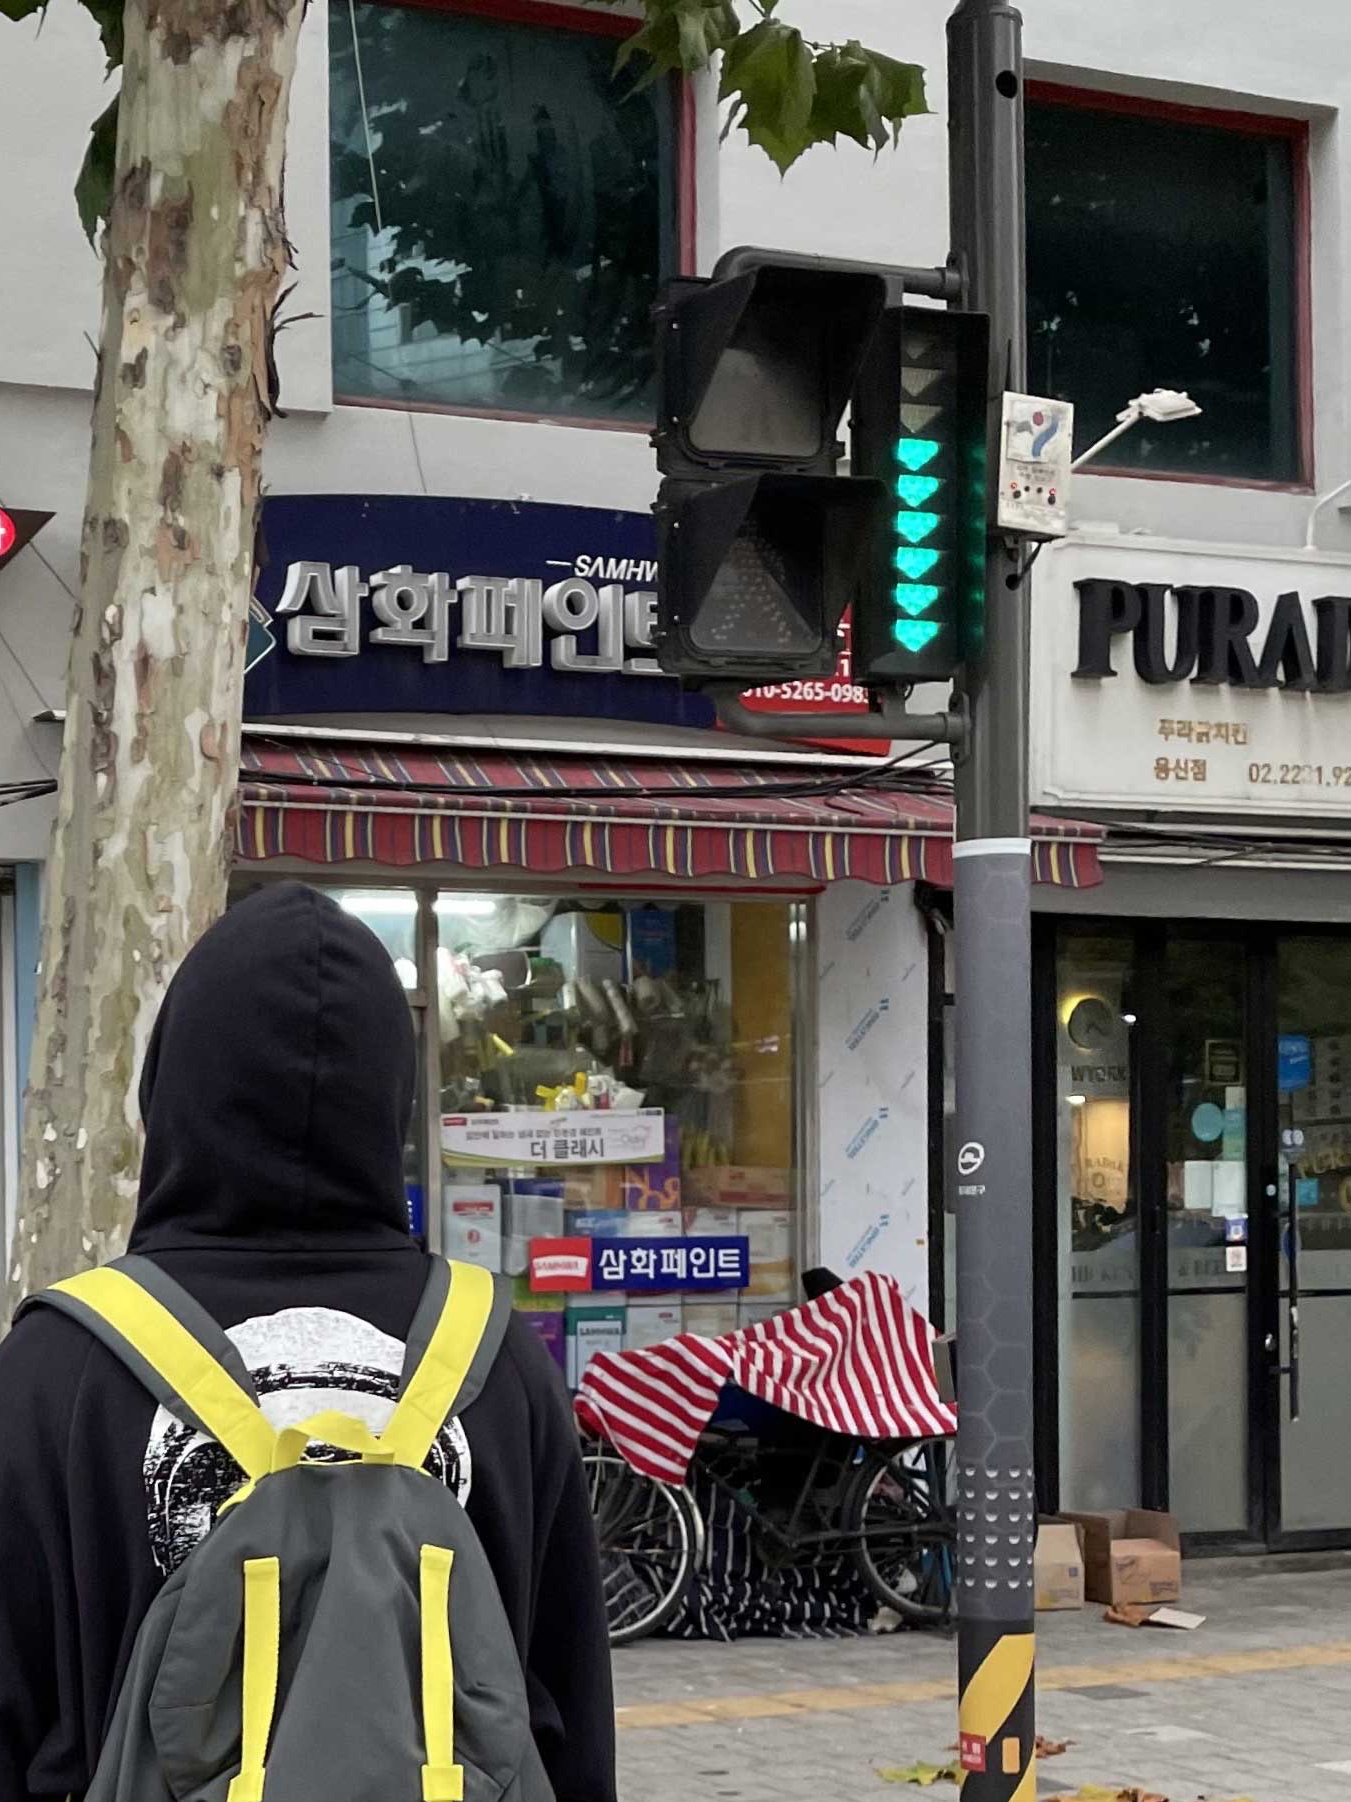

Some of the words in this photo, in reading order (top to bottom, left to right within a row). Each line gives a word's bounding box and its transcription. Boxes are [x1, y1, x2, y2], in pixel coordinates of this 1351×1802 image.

[530, 1139, 547, 1159] 더
[553, 1137, 604, 1159] 클래시
[599, 1247, 742, 1281] 삼화페인트
